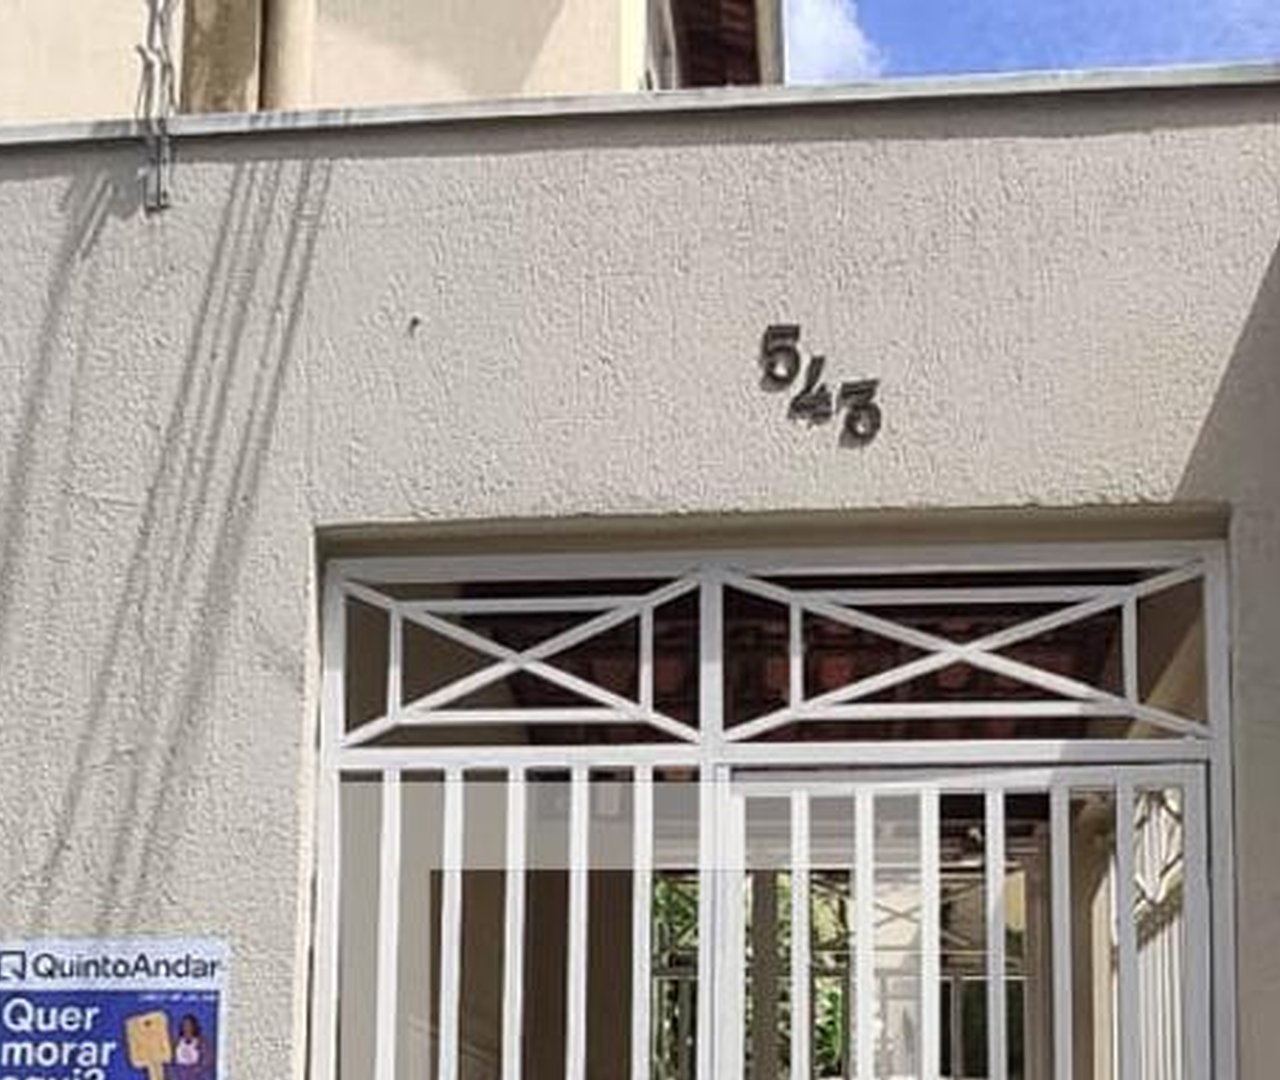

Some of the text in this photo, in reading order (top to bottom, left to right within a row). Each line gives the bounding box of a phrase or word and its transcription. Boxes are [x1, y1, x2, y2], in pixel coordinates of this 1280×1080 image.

[32, 953, 219, 979] QuintoAndar
[2, 997, 100, 1033] Quer
[1, 1041, 117, 1067] morar
